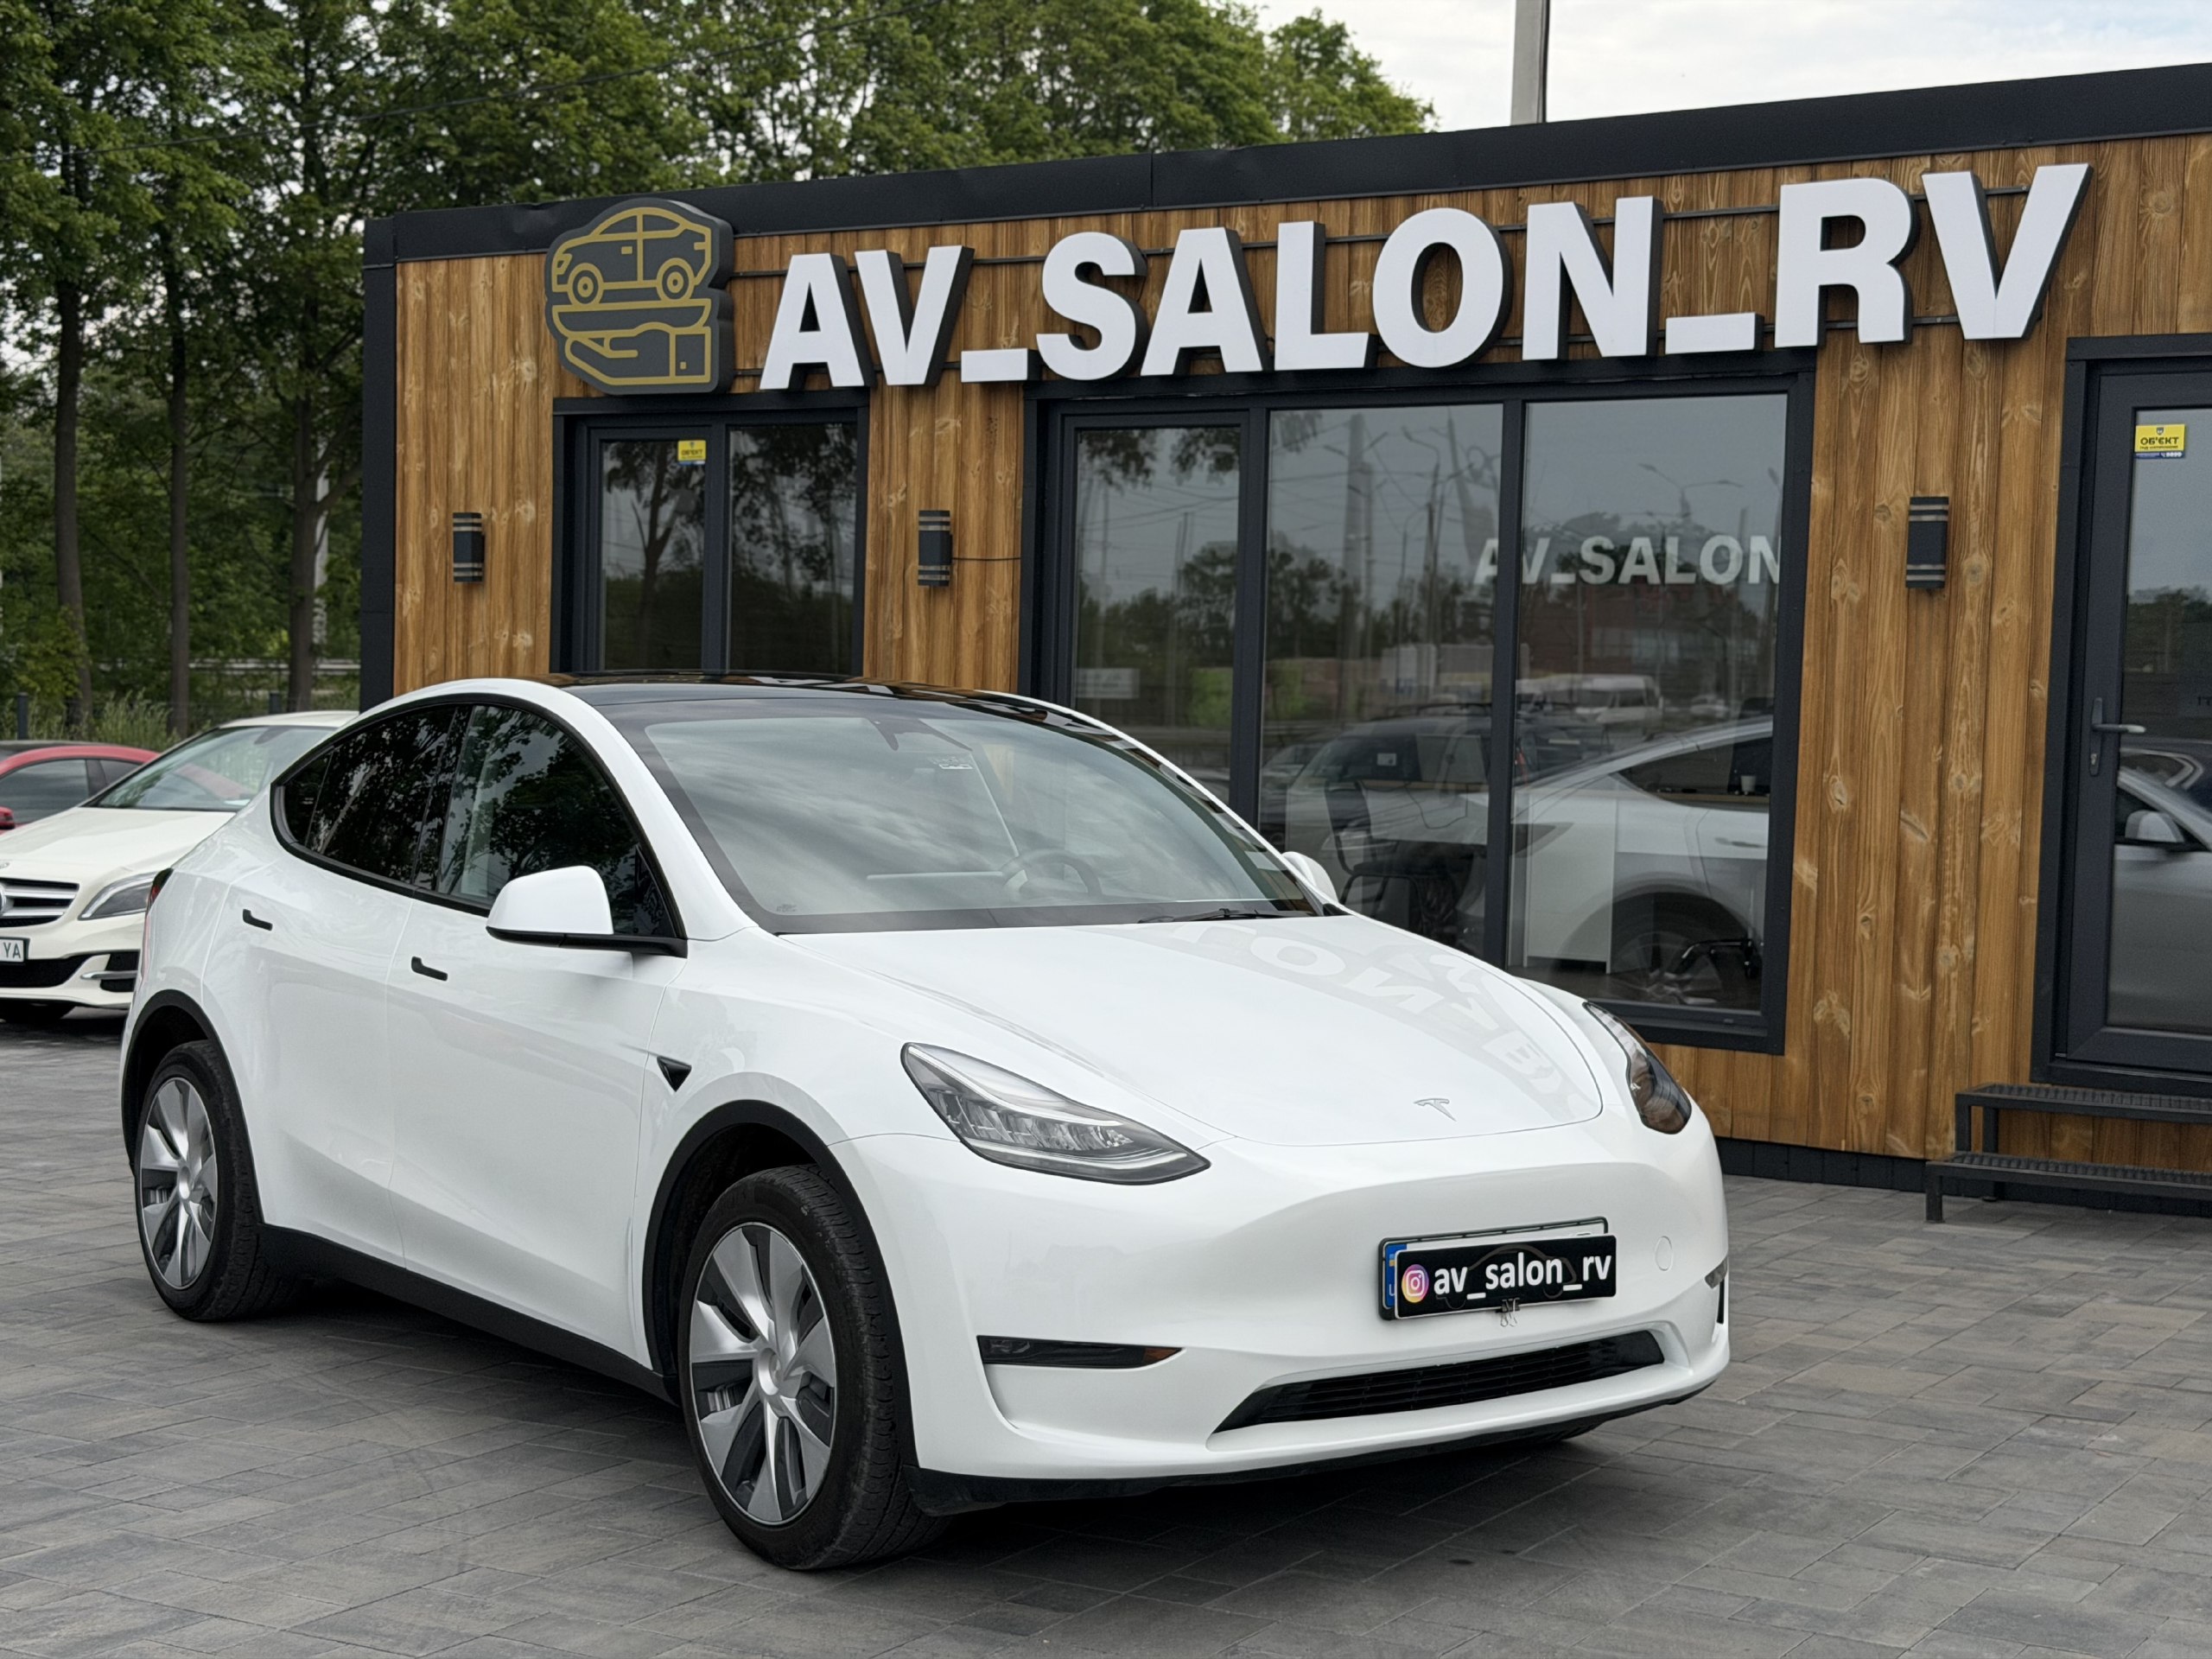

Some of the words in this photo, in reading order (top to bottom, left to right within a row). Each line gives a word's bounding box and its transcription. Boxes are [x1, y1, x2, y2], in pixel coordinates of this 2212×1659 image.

[760, 163, 2088, 389] AV_SALON_RV
[3, 942, 21, 958] YA
[1434, 1253, 1611, 1300] av_salon_rv
